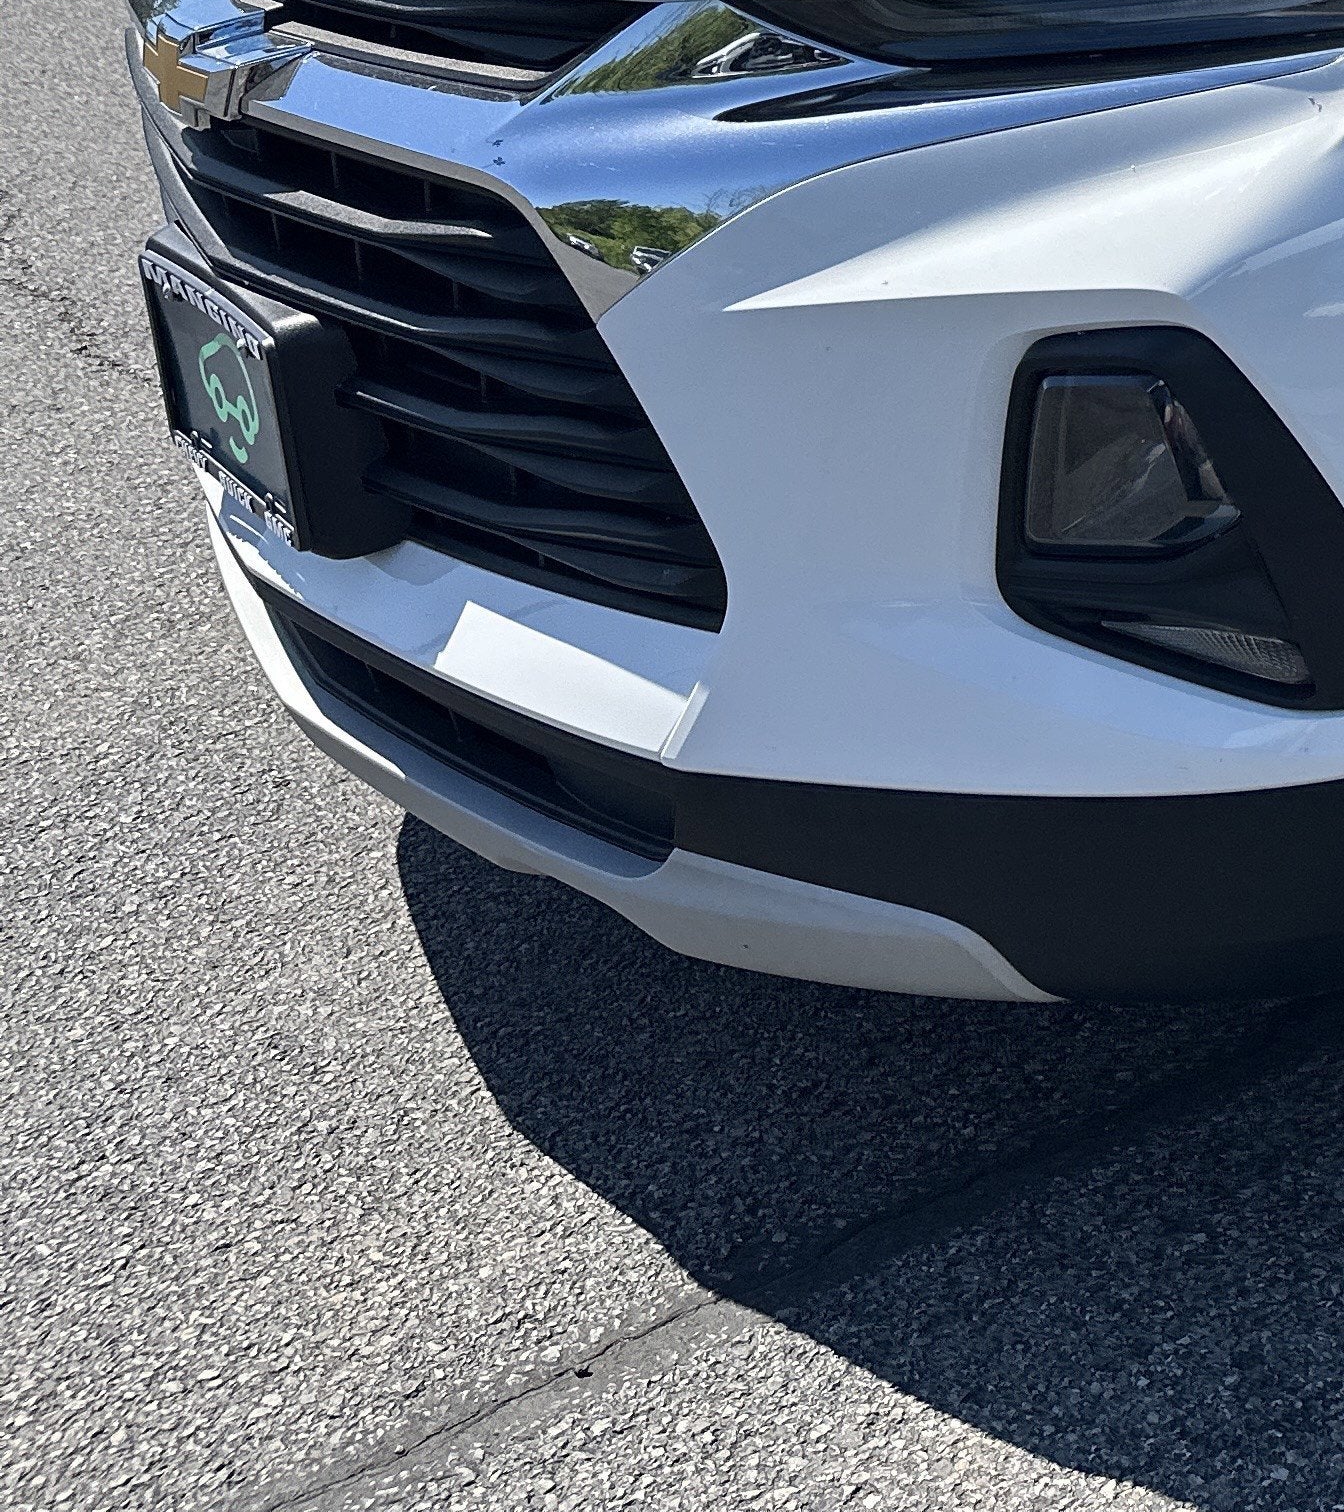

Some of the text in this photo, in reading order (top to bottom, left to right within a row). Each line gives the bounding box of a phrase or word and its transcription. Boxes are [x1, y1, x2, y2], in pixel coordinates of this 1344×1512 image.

[141, 258, 261, 361] MANGINO
[218, 470, 253, 514] BUICK
[264, 510, 293, 548] GMC
